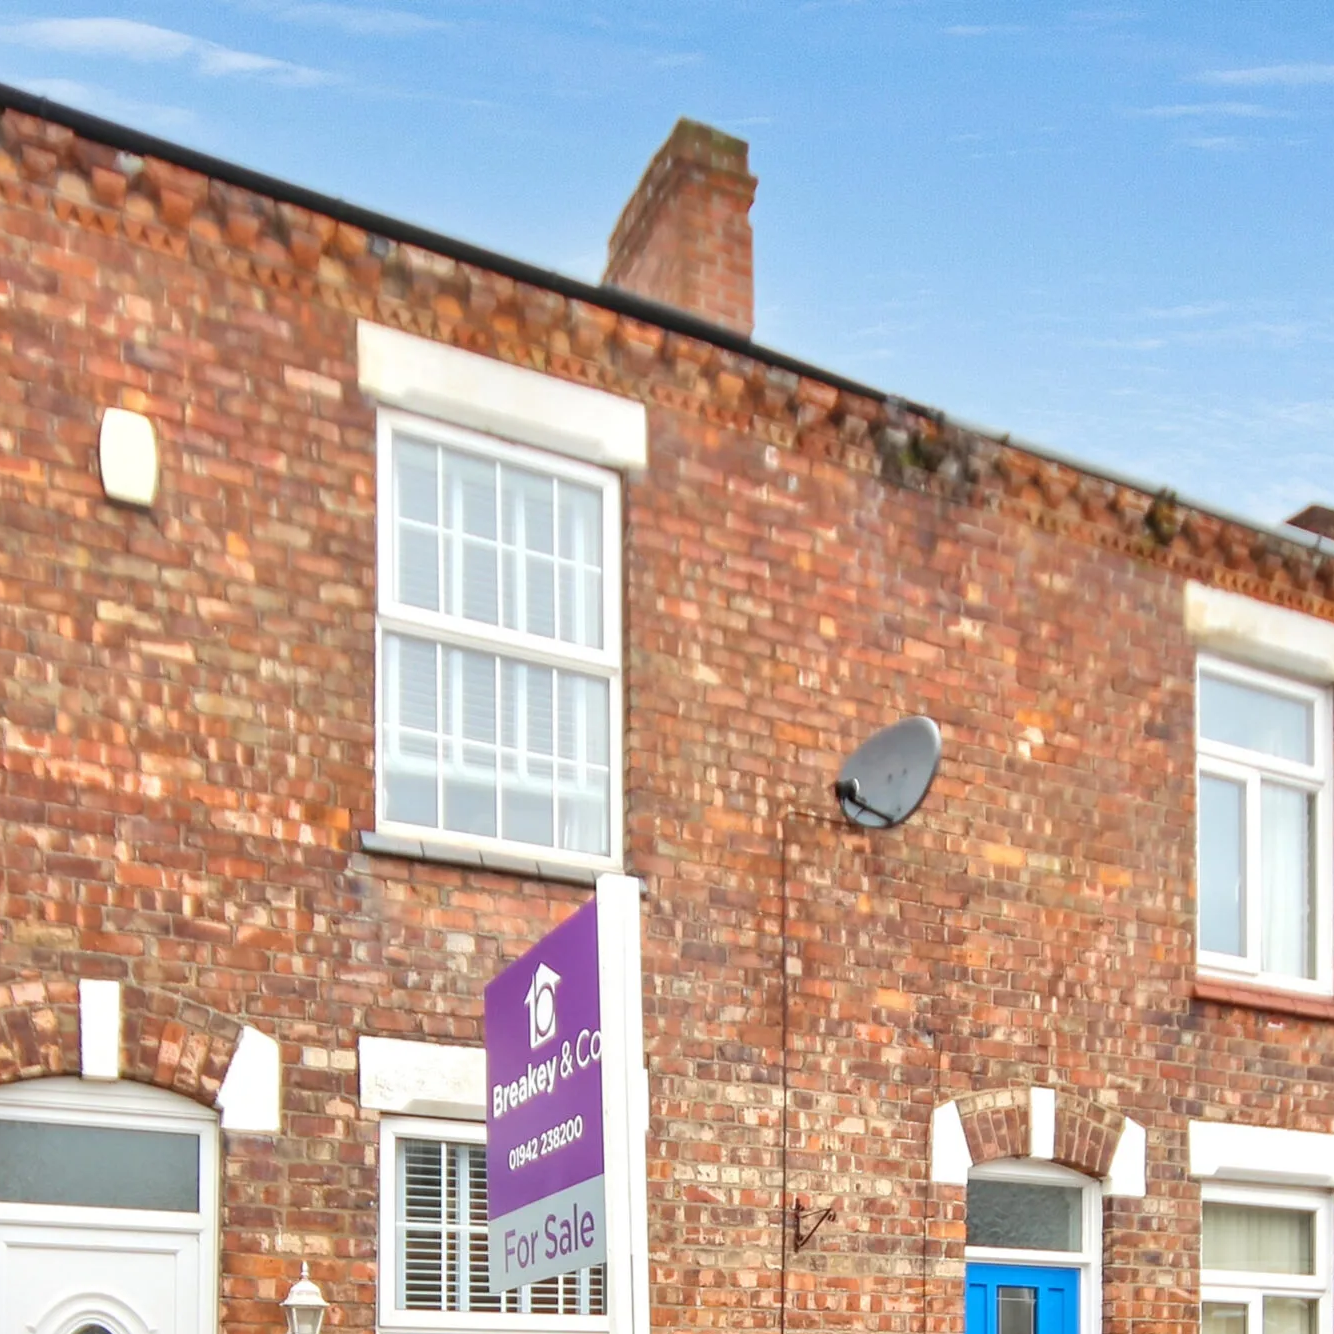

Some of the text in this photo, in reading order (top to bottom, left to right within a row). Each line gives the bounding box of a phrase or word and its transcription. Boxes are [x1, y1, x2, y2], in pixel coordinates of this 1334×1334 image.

[492, 1028, 603, 1119] Breakey & Co
[508, 1114, 584, 1171] 01942 238200
[504, 1202, 595, 1274] For Sale
